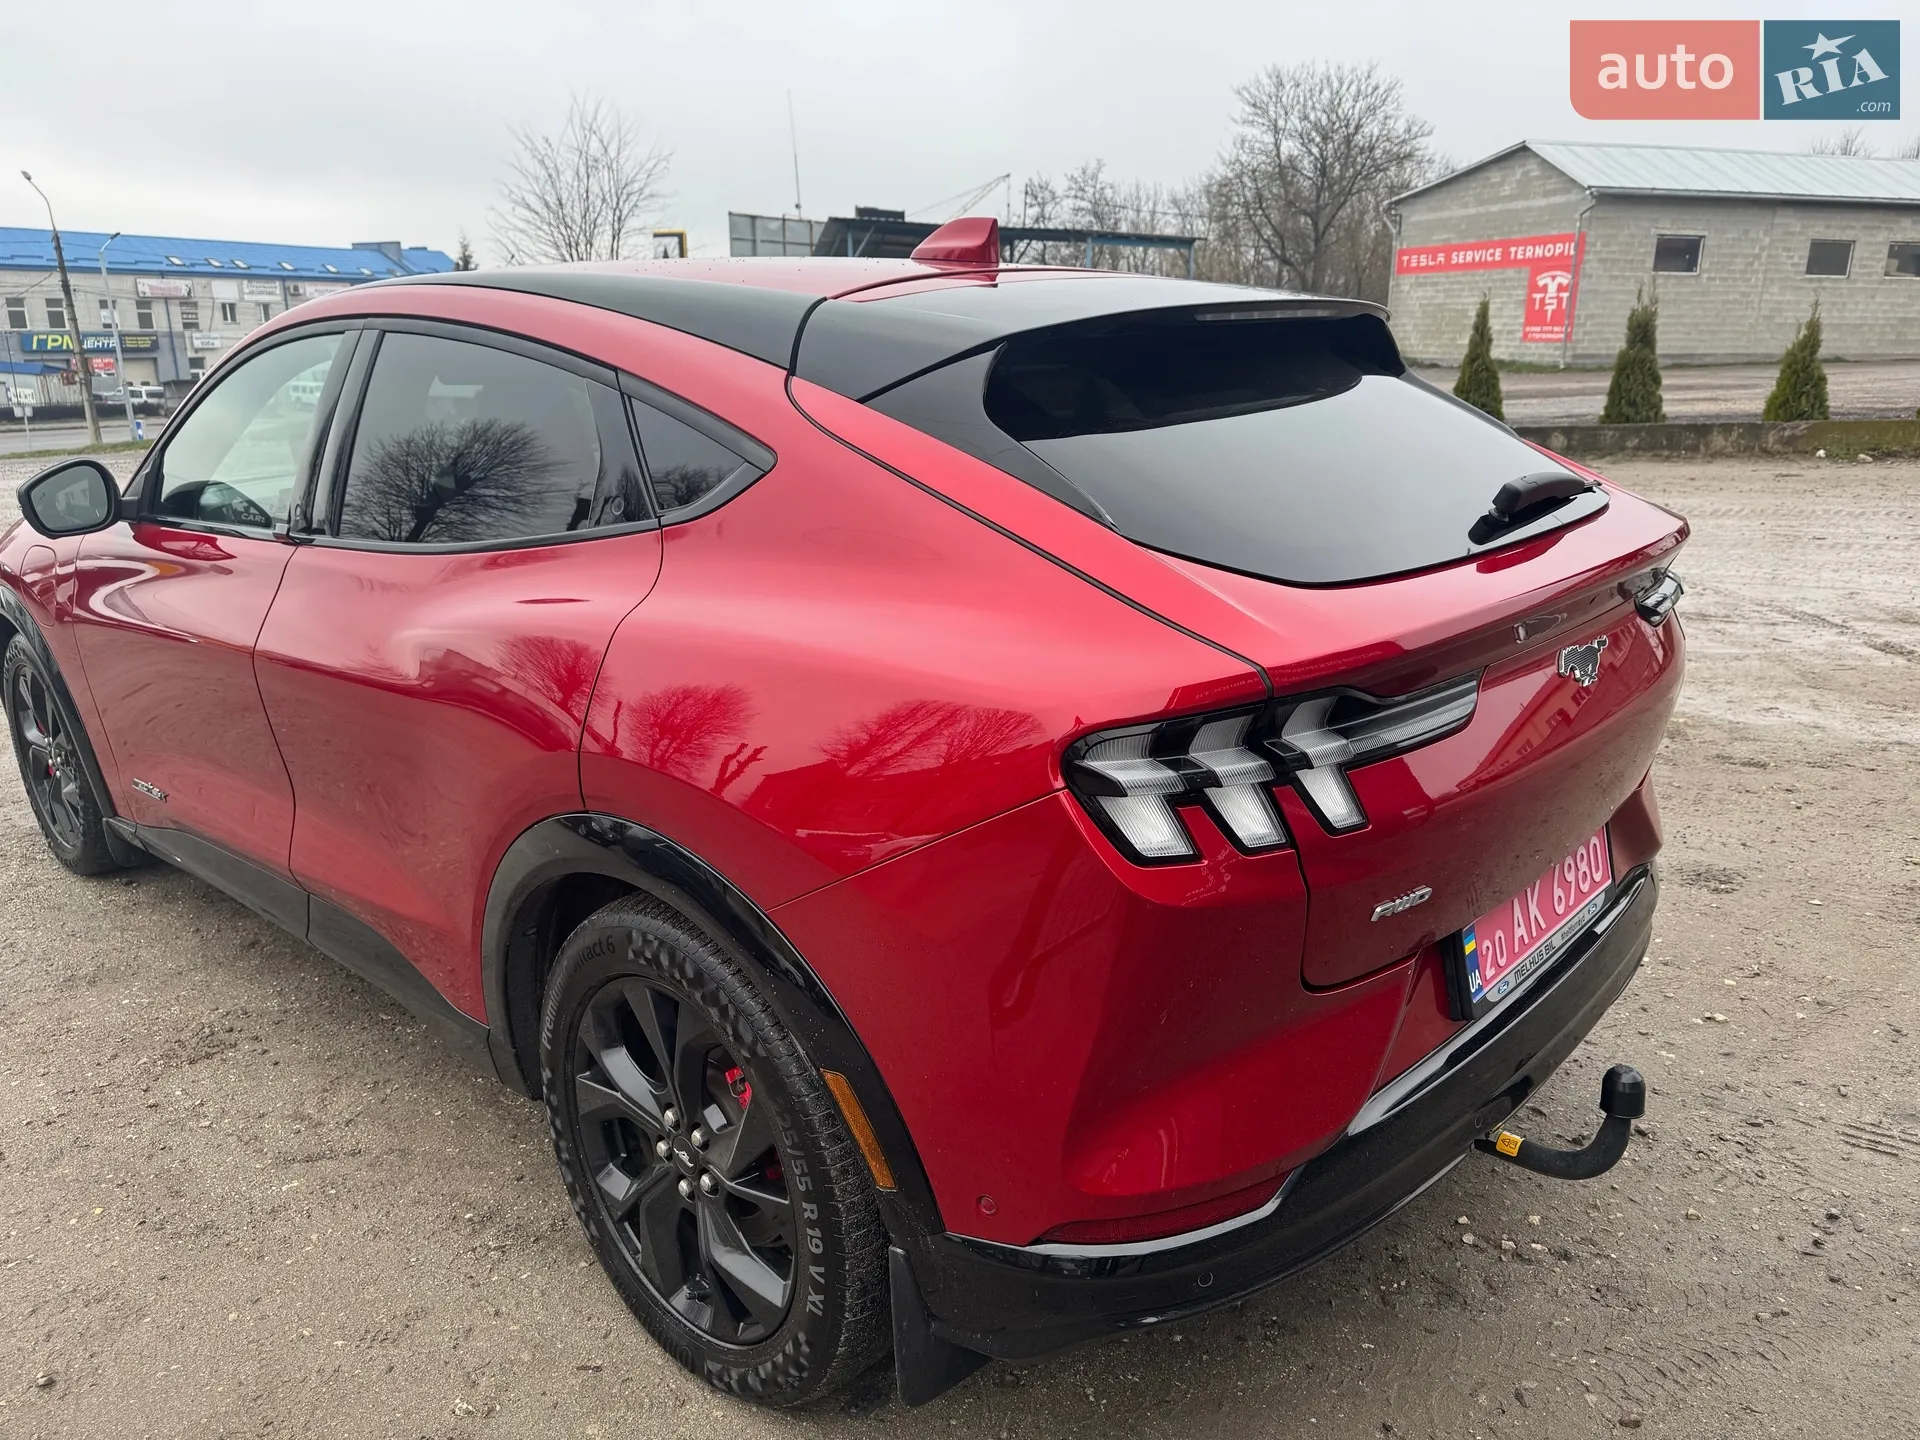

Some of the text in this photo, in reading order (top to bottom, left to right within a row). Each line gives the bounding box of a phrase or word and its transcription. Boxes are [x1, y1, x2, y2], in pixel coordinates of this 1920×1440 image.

[1402, 253, 1446, 268] TESLA
[1450, 247, 1503, 265] SERVICE
[1370, 886, 1433, 922] AWD
[1482, 835, 1603, 981] 20 AK 6980
[1514, 949, 1544, 984] MELHUS
[1544, 940, 1556, 956] BIL
[1468, 969, 1482, 993] UA
[801, 1201, 819, 1220] R
[806, 1227, 824, 1255] 19
[808, 1265, 825, 1284] V
[806, 1287, 825, 1316] XL
